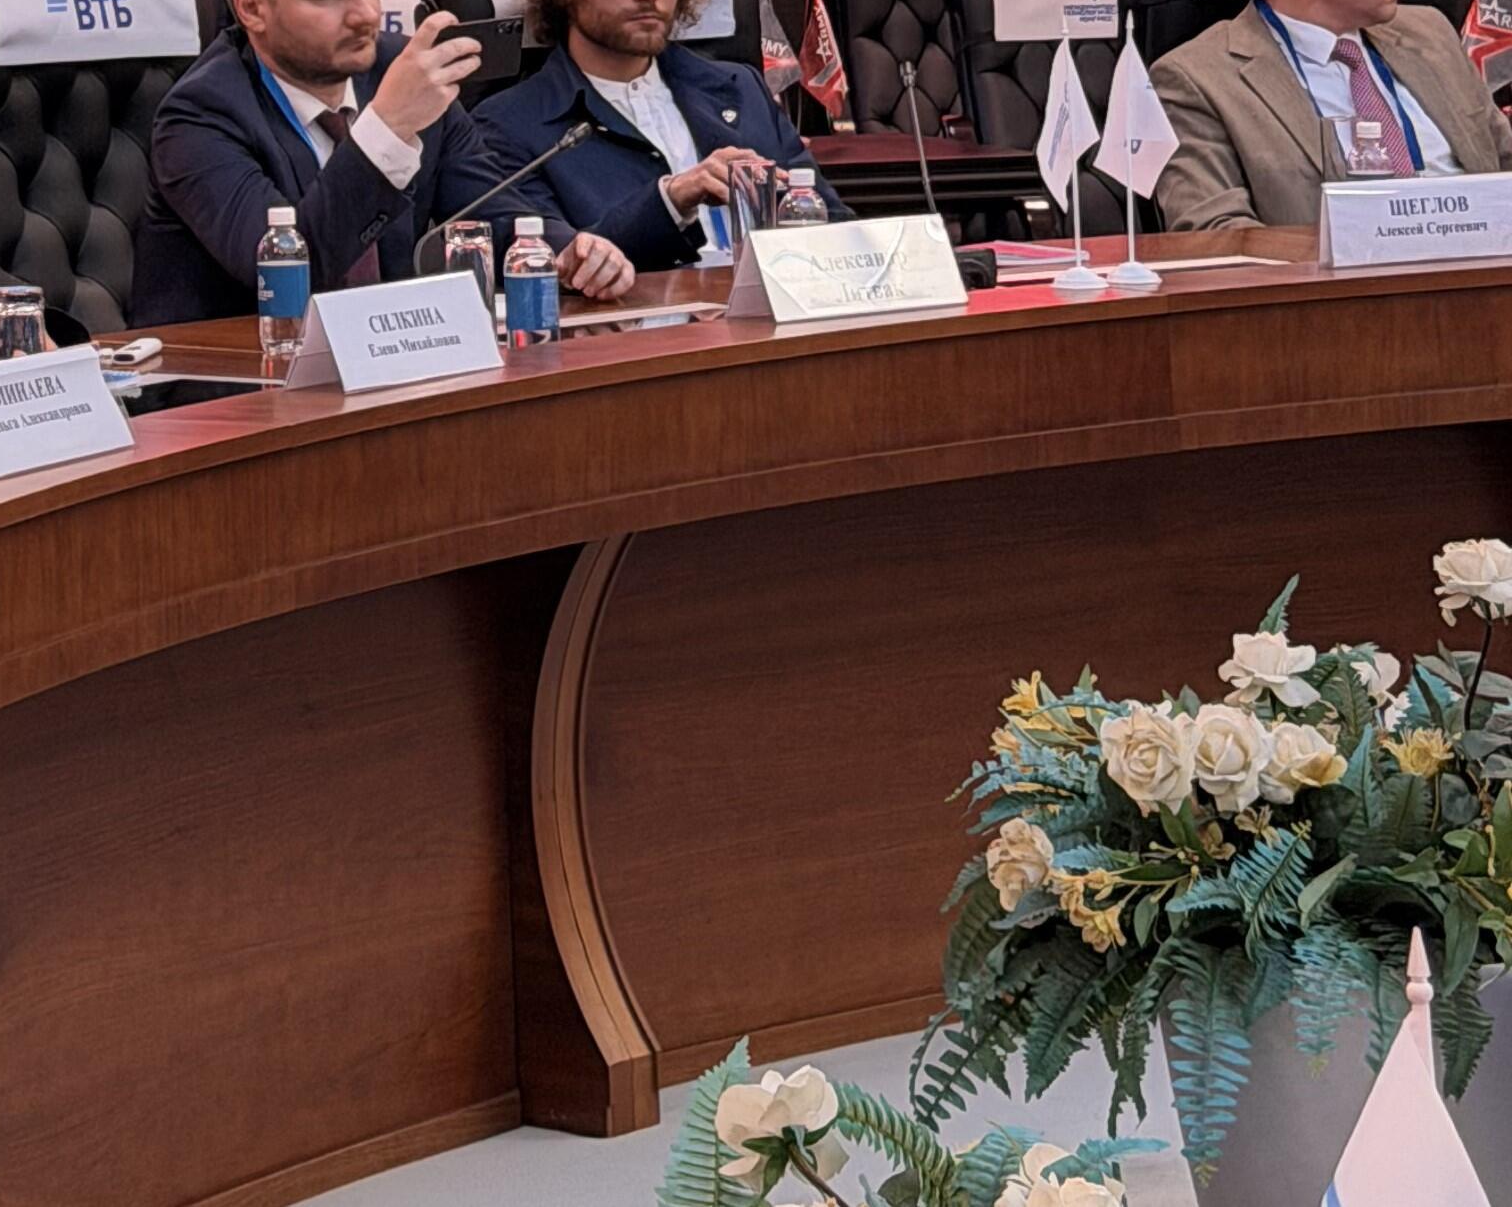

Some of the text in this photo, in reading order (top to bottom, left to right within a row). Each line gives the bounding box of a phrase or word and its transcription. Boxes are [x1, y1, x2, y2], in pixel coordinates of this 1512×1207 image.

[1388, 196, 1470, 217] ЩЕГЛОВ
[1375, 221, 1489, 238] Алексей Сергеевич
[368, 306, 446, 334] СИЛКИНА
